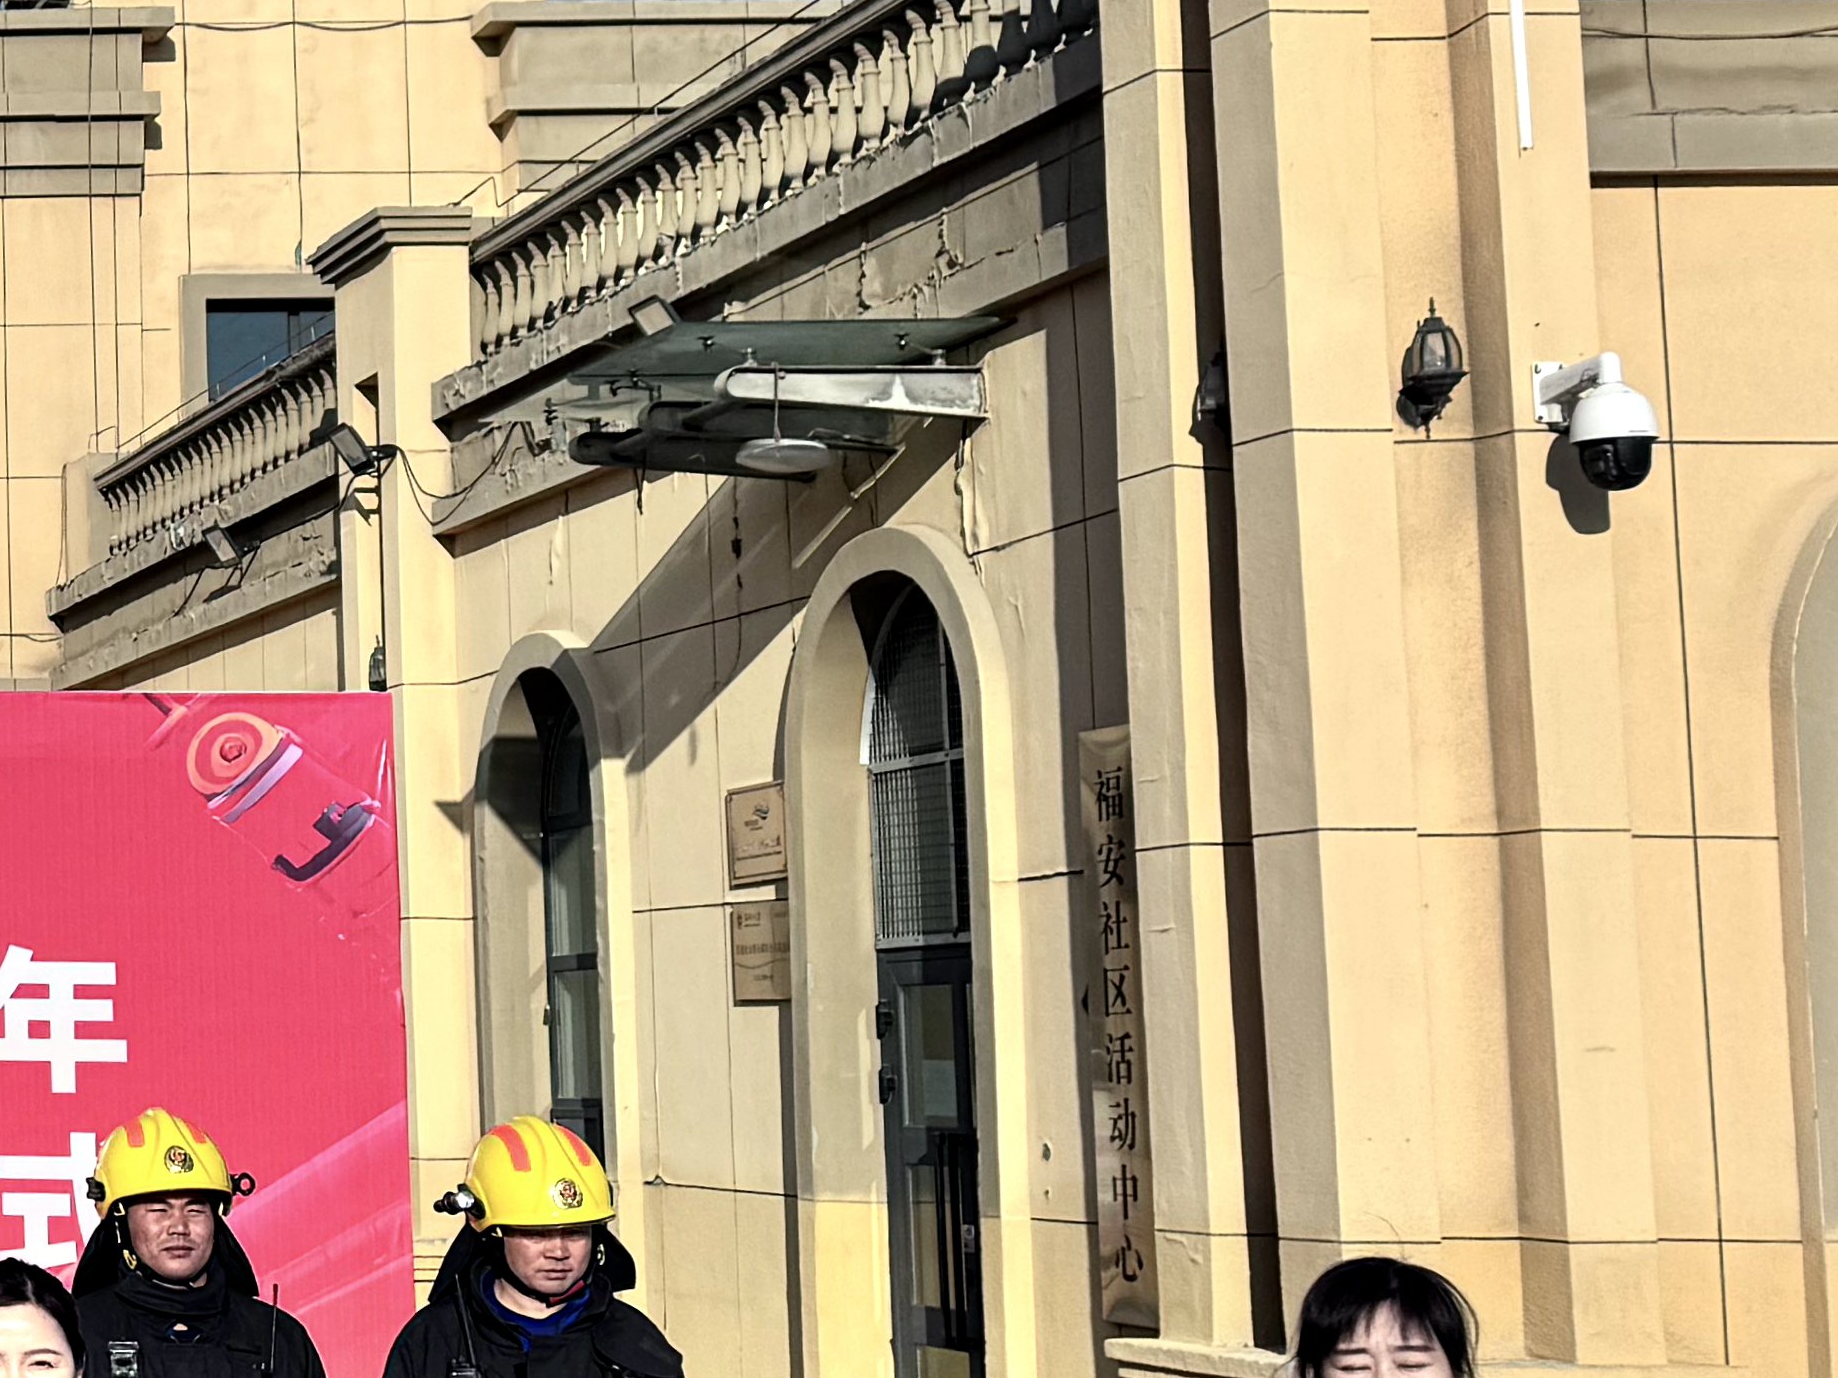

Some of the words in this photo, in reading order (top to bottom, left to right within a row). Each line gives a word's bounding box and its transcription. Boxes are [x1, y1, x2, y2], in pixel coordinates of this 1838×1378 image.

[1093, 766, 1145, 1285] 福安社区活动中心
